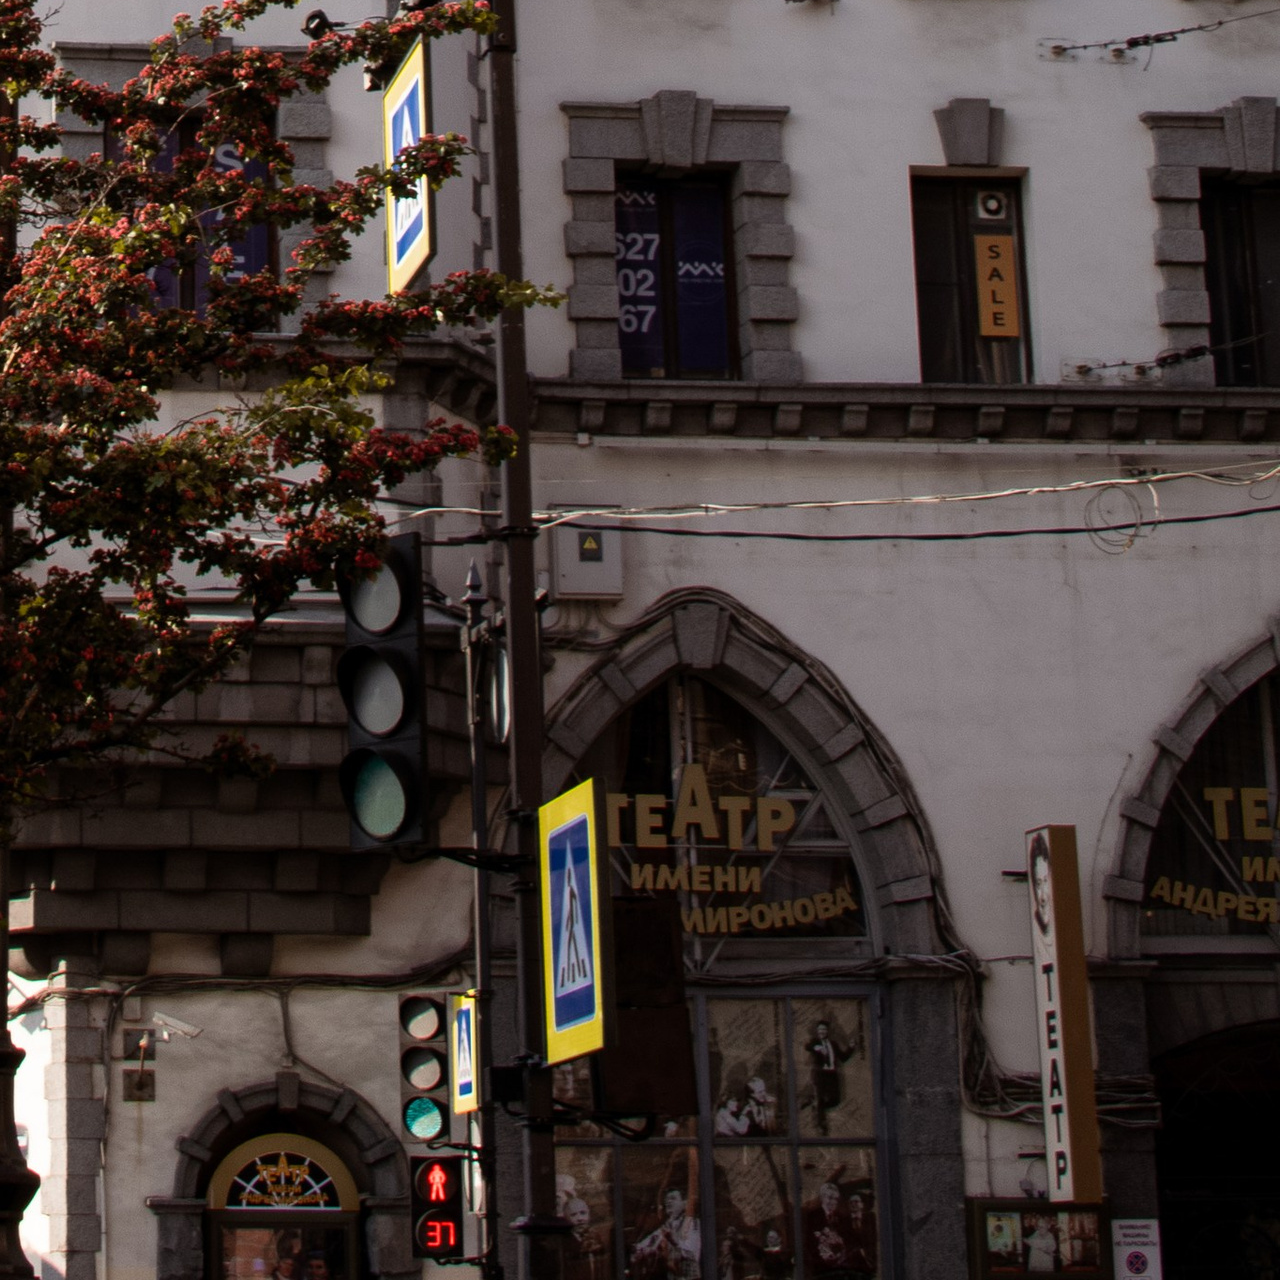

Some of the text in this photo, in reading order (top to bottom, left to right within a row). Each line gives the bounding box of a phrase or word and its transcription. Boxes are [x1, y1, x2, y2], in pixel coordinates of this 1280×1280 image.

[618, 268, 655, 296] 02
[987, 244, 1006, 326] SALE
[619, 304, 656, 332] 67
[606, 763, 795, 851] ТЕАТР
[1203, 786, 1280, 841] ТЕ
[631, 863, 762, 893] ИМЕНИ
[1149, 876, 1279, 923] АНДРЕЯ
[680, 886, 858, 935] МИРОНОВА
[1042, 963, 1066, 1189] ТЕАТР
[256, 1156, 309, 1181] ТЕАТР
[427, 1221, 455, 1246] 37
